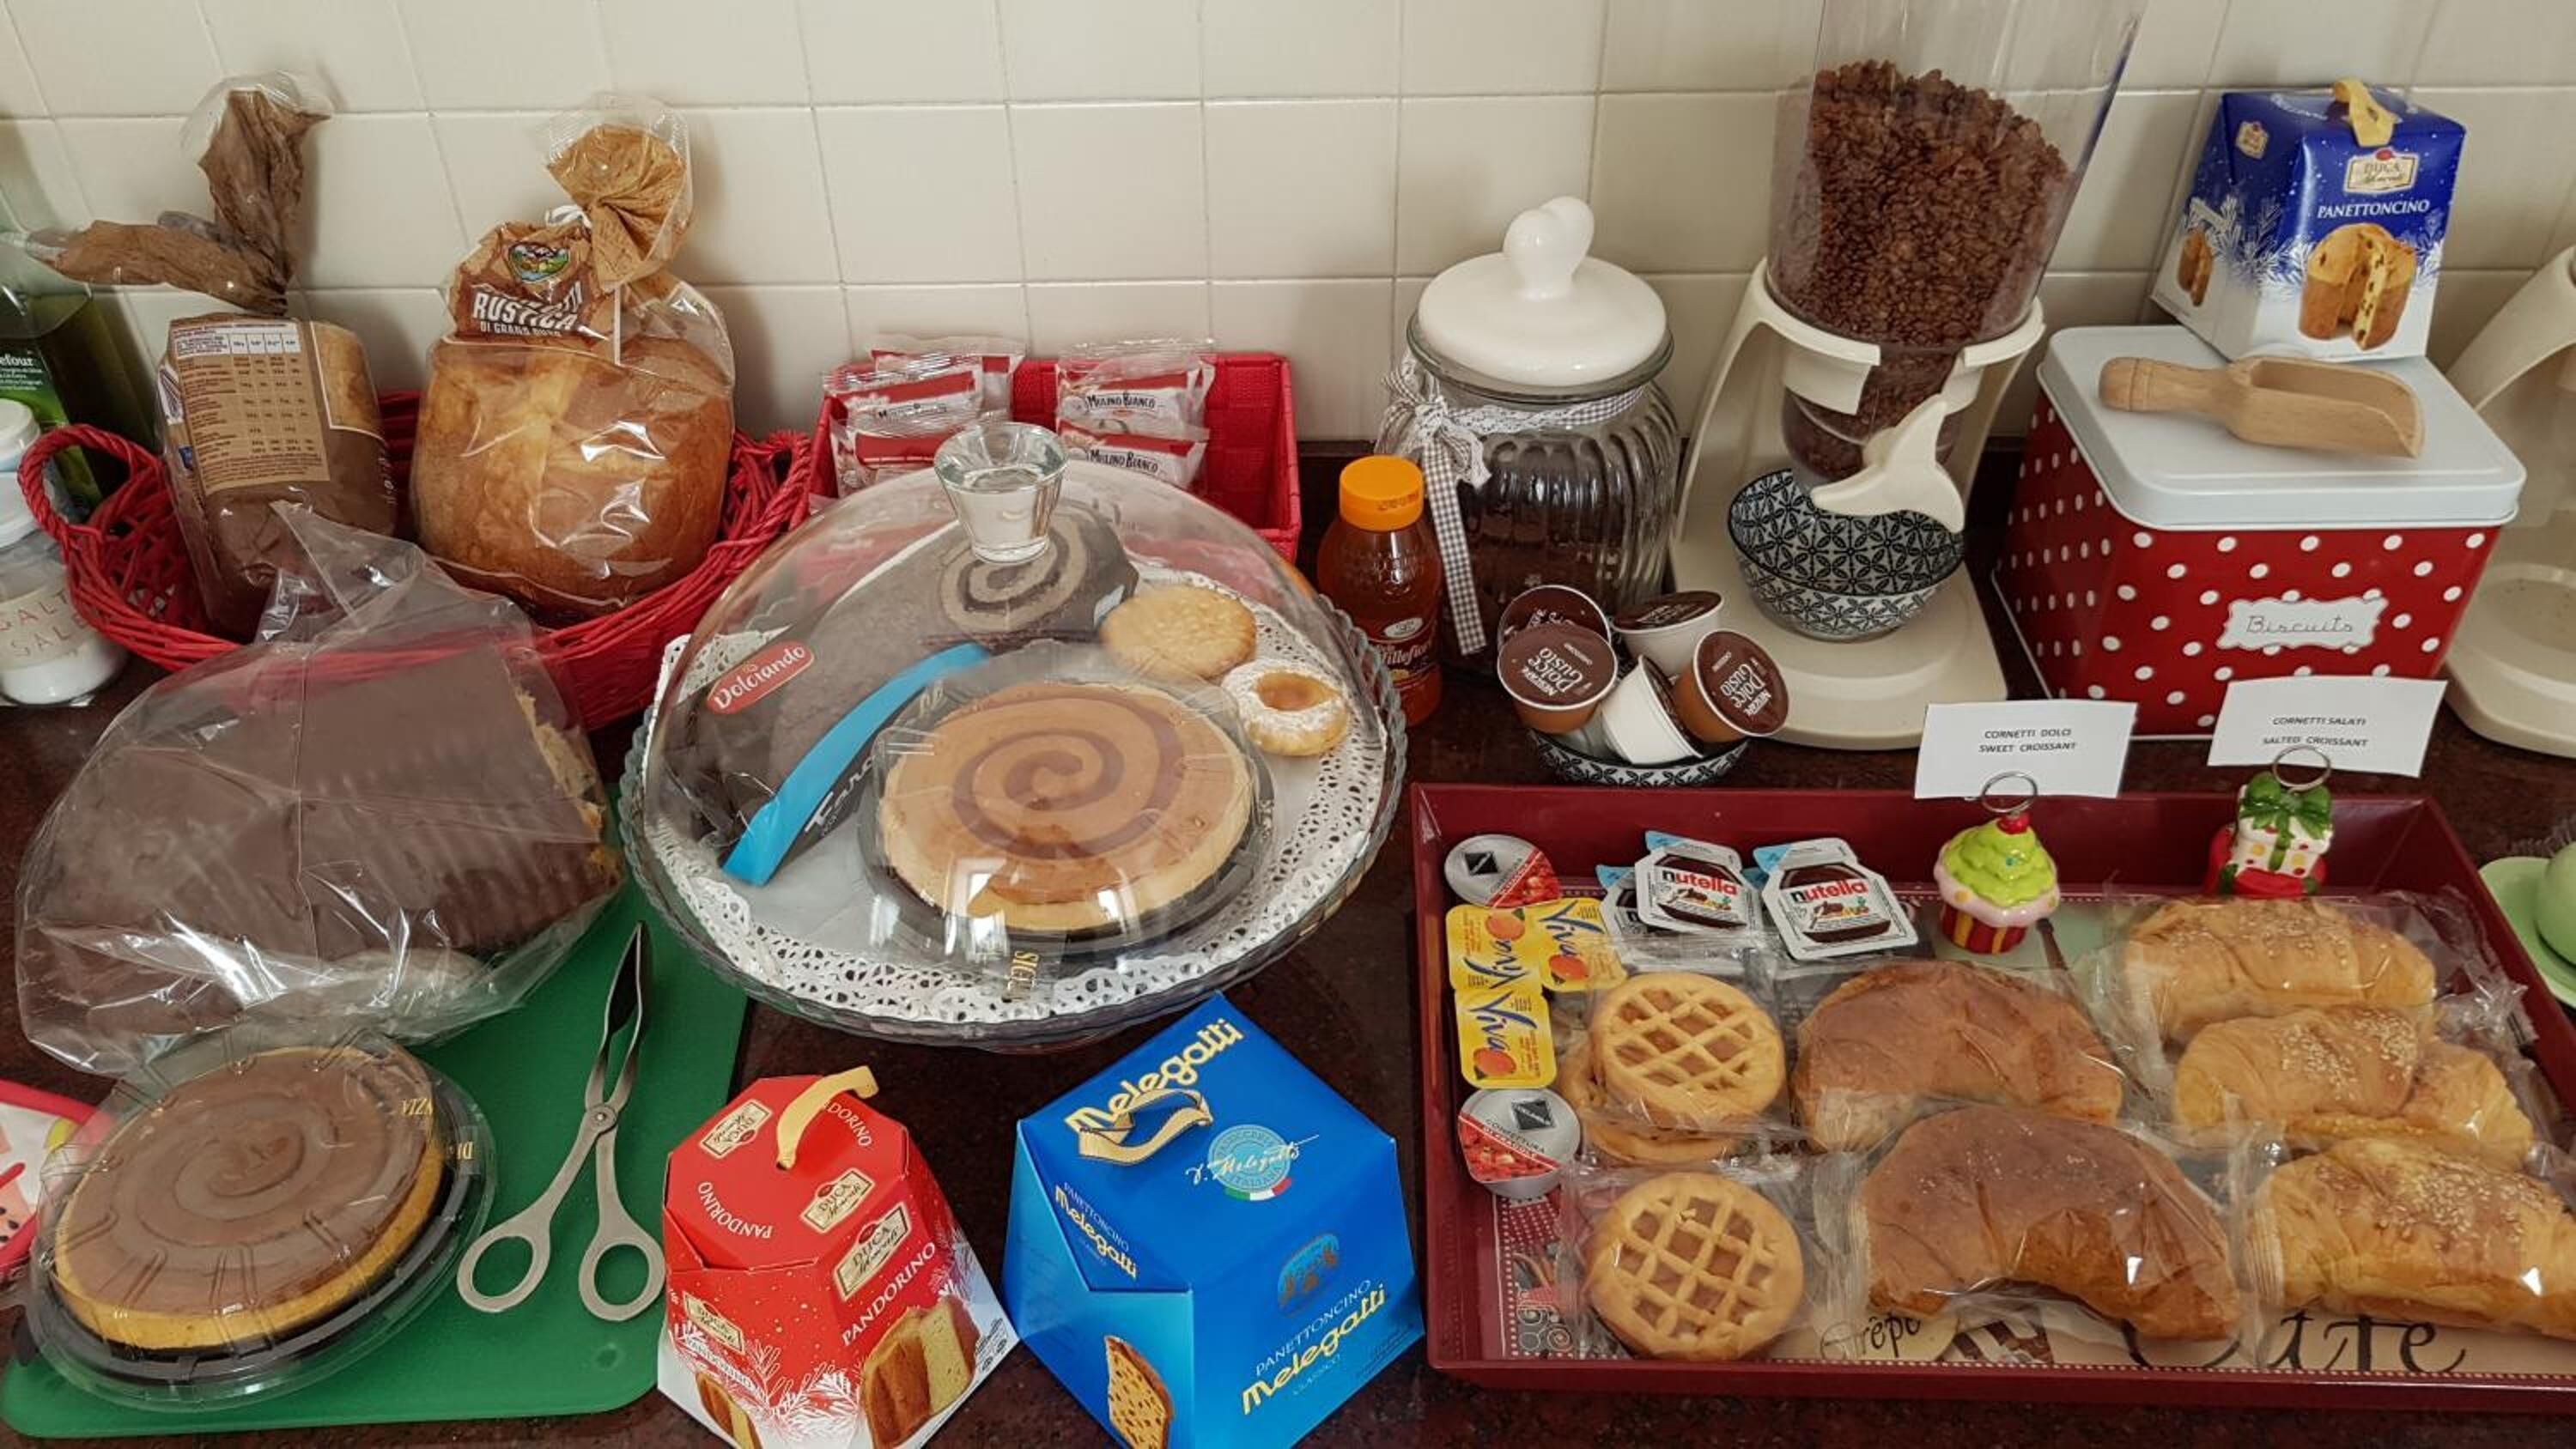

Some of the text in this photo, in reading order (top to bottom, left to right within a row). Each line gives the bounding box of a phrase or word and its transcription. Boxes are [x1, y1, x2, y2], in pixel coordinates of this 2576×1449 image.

[2318, 198, 2431, 219] PANETTONCINO
[473, 292, 578, 330] RUSTICA
[1086, 392, 1156, 409] MULINO BIANCO
[2246, 614, 2353, 634] Biscuits
[714, 646, 805, 710] Dolciando
[1978, 743, 2076, 753] SWEET CROISSANT
[1984, 729, 2037, 739] CORNETTI
[1662, 870, 1738, 895] nutella
[1790, 880, 1869, 902] nutella
[1538, 899, 1606, 956] Viva
[1462, 939, 1530, 990] Viva
[1468, 990, 1538, 1052] Viva
[1064, 1017, 1244, 1131] Melegatti
[826, 1101, 873, 1147] DORINO
[696, 1180, 775, 1240] PANDORINO
[1055, 1184, 1137, 1279] Melegatti
[1064, 1181, 1129, 1252] PANETTONCINO
[854, 1227, 891, 1266] DUCA
[841, 1240, 938, 1347] PANDORINO
[1242, 1282, 1385, 1416] Melegatti
[1255, 1279, 1370, 1377] PANETTONCINO
